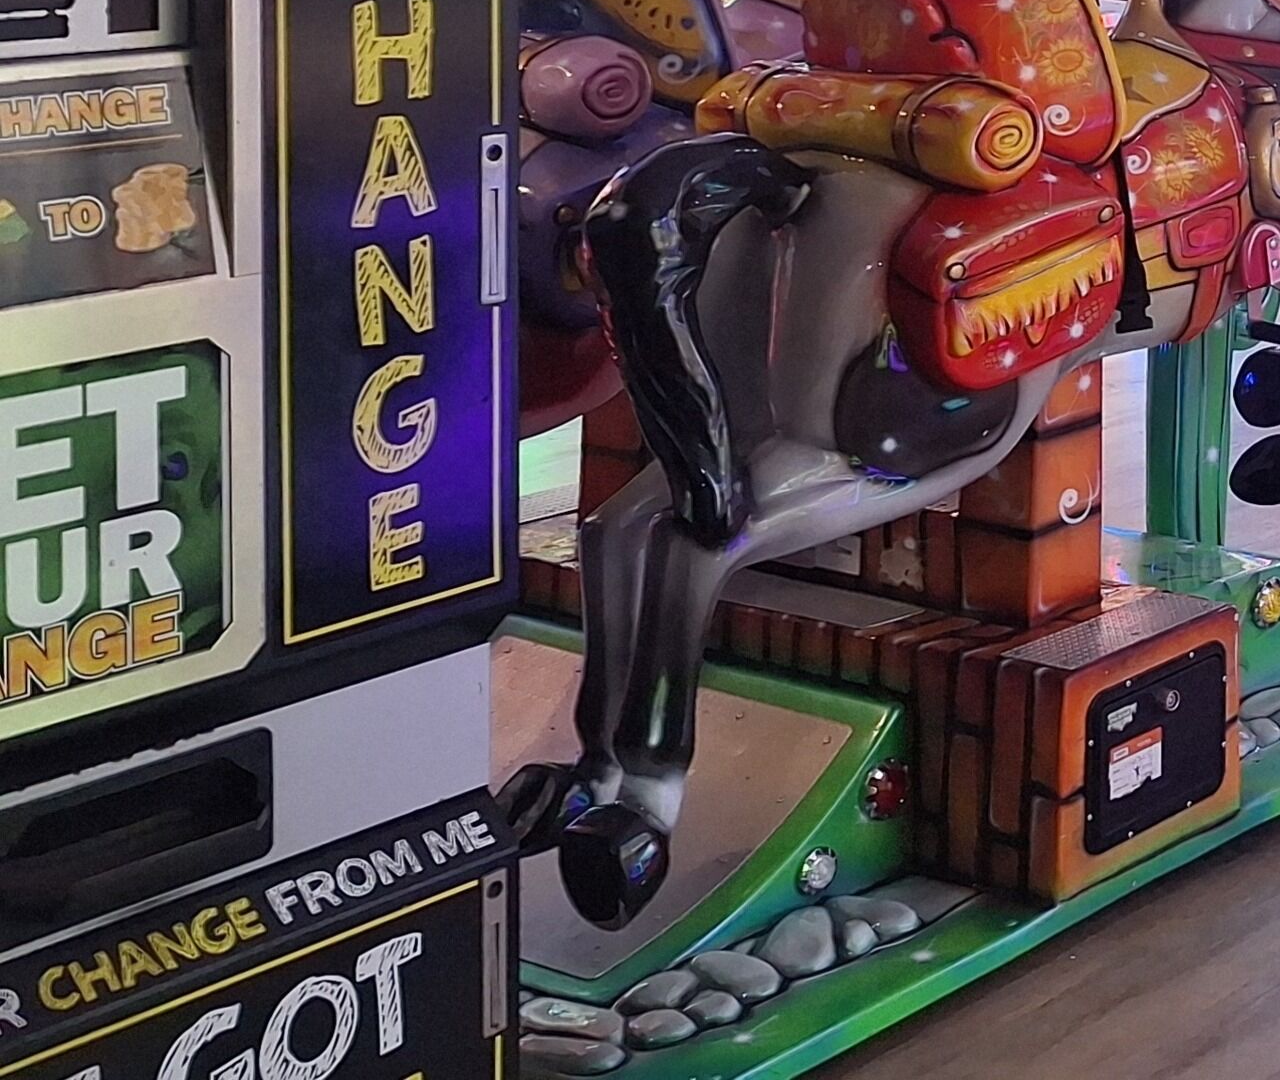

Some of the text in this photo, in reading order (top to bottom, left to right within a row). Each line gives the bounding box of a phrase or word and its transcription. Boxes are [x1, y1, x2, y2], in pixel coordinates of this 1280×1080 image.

[40, 196, 105, 241] TO
[3, 509, 183, 629] UR
[0, 591, 183, 700] NGE
[37, 897, 267, 1012] CHANGE
[265, 840, 424, 926] FROM
[421, 810, 496, 866] ME
